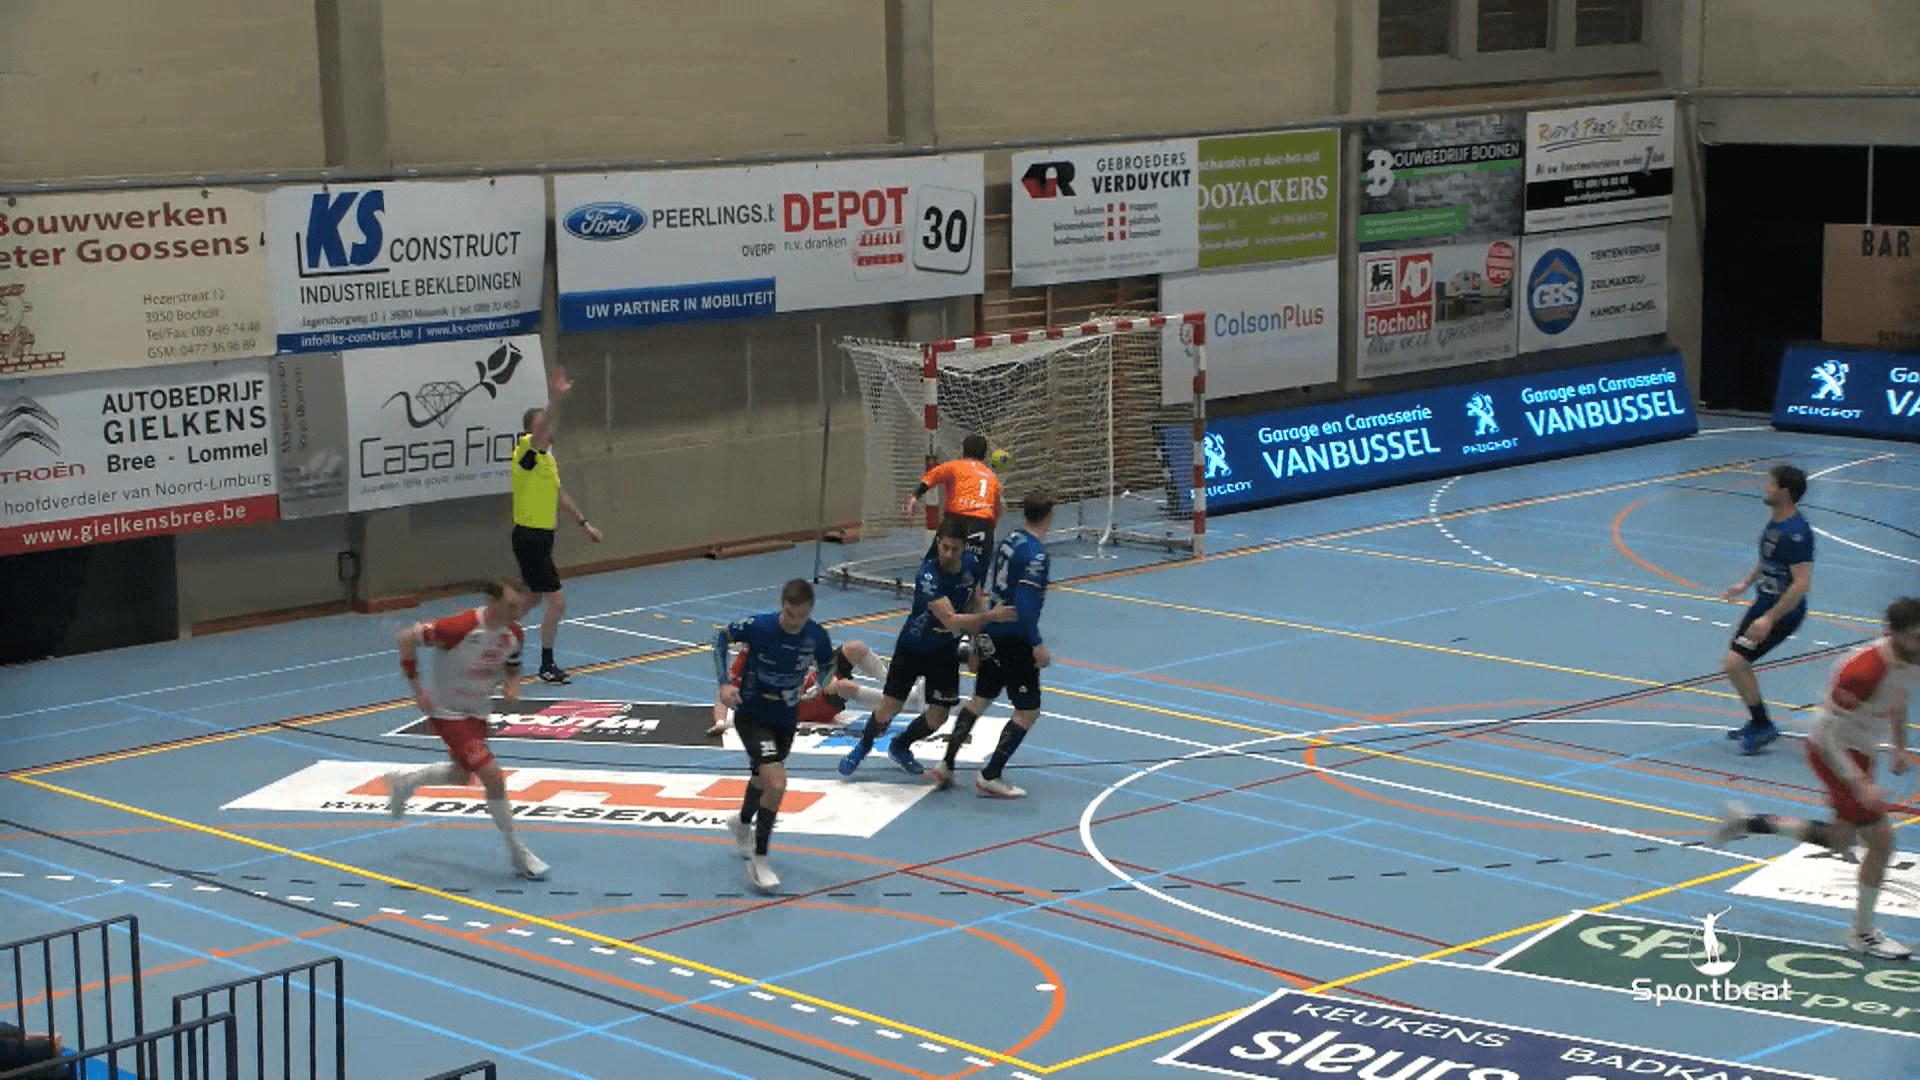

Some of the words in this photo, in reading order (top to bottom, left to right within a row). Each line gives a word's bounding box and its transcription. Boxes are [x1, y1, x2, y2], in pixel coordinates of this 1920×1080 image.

[1097, 152, 1186, 172] GEBROEDERS
[1091, 169, 1191, 194] VERDUYCKT
[580, 207, 632, 234] Ford
[783, 186, 908, 232] DEPOT
[305, 190, 385, 269] KS
[805, 235, 847, 250] dranken
[922, 206, 967, 253] 30
[1861, 229, 1911, 258] BAR
[77, 234, 250, 264] Goossens
[390, 231, 521, 263] CONSTRUCT
[300, 279, 410, 304] INDUSTRIELE
[415, 271, 522, 297] BEKLEDINGEN
[586, 303, 610, 319] UW
[613, 299, 679, 316] PARTNER
[684, 296, 697, 311] IN
[701, 290, 775, 309] MOBILITEIT
[1214, 304, 1325, 337] ColsonPlus
[301, 328, 414, 348] info@ks-construct.be
[1367, 311, 1428, 336] Bocholt
[102, 380, 264, 415] AUTOBEDRIJF
[1521, 387, 1576, 404] Garage
[1578, 384, 1597, 396] en
[1598, 367, 1677, 393] Carrosserie
[103, 406, 267, 445] GIELKENS
[1258, 423, 1320, 445] Garage
[1322, 420, 1343, 434] en
[1345, 404, 1433, 431] Carrosserie
[1525, 389, 1685, 437] VANBUSSEL
[1787, 405, 1863, 419] PEUGEOT
[107, 454, 156, 473] Bree
[188, 438, 268, 464] Lommel
[360, 436, 455, 479] Casa
[1262, 427, 1442, 479] VANBUSSEL
[123, 486, 150, 501] van
[155, 472, 272, 496] Noord-Limburg
[979, 478, 988, 498] 1
[23, 503, 247, 545] www.gielkensbree.be
[1293, 1003, 1512, 1047] KEUKENS
